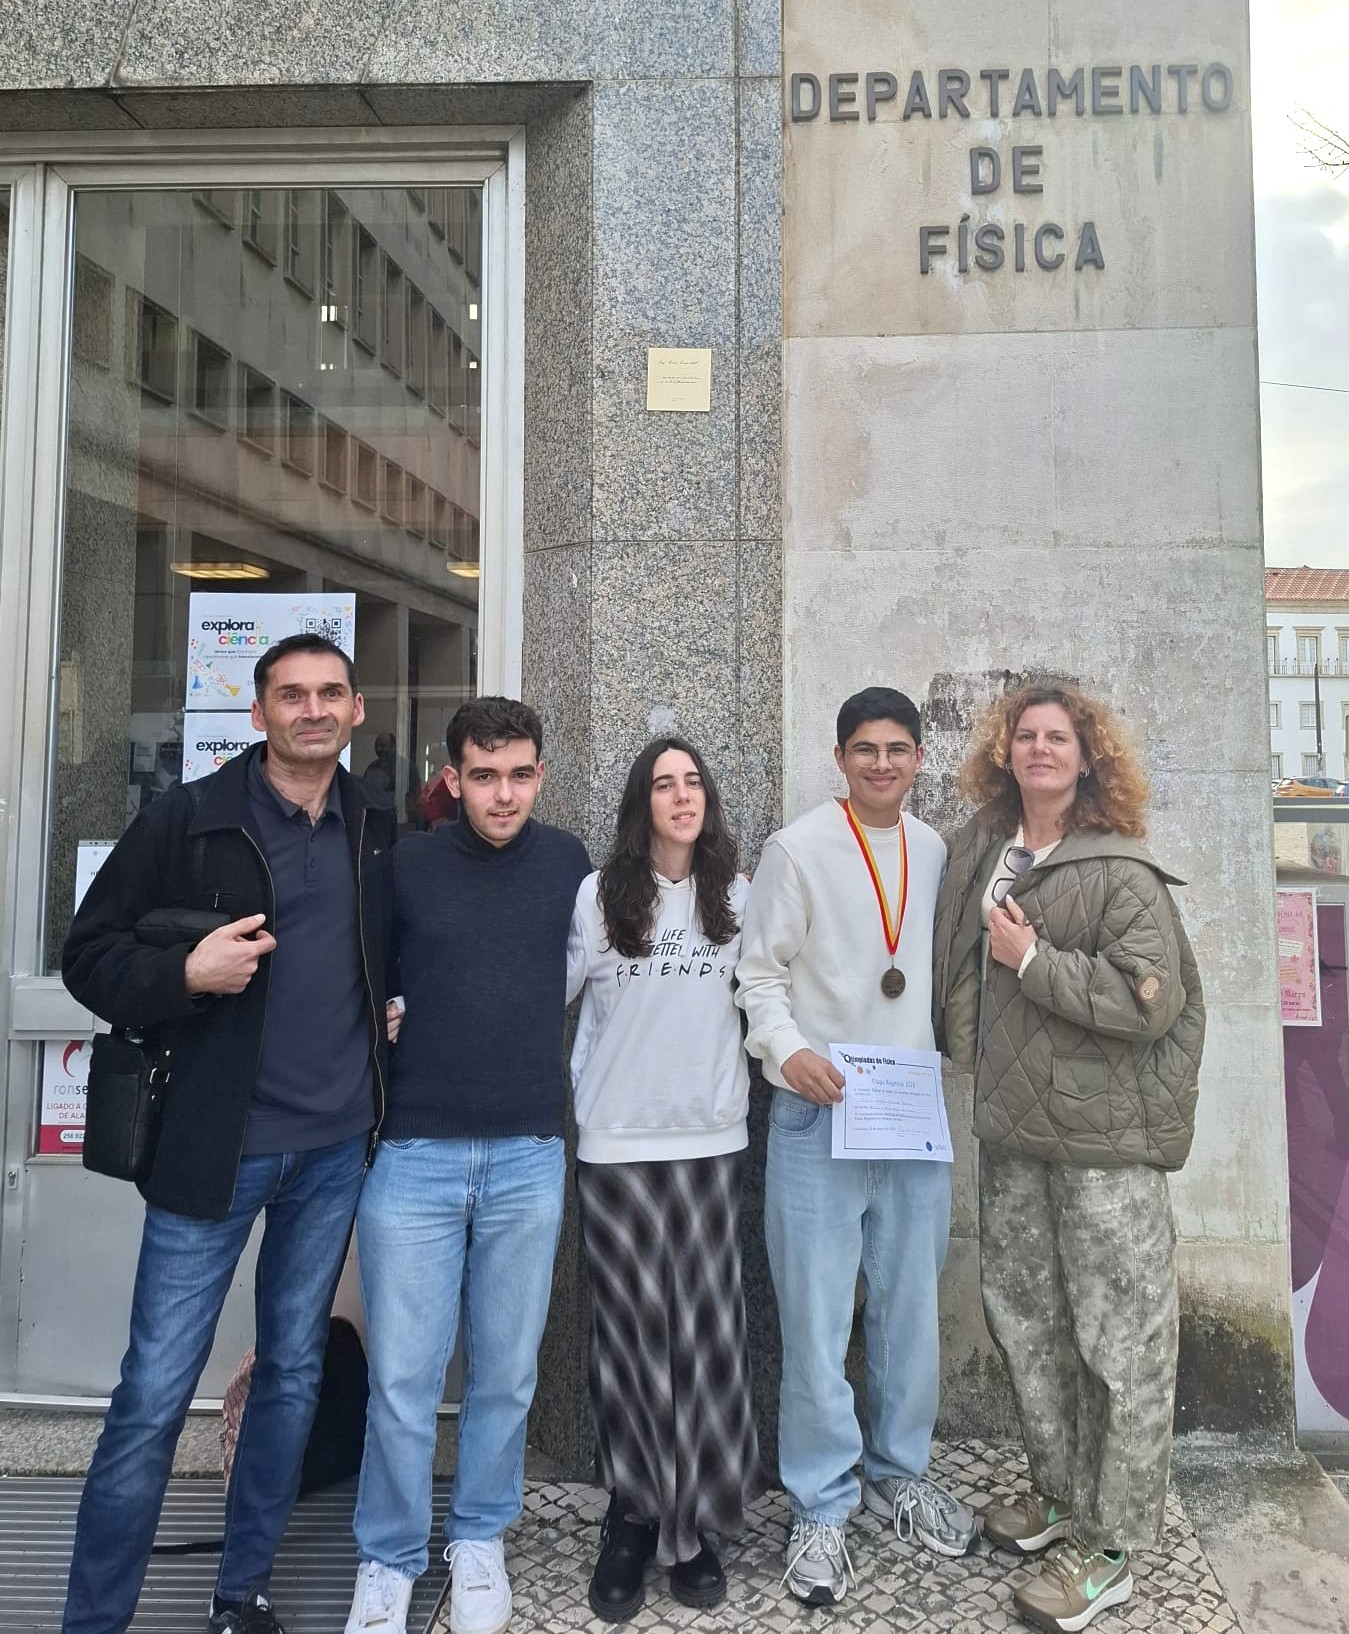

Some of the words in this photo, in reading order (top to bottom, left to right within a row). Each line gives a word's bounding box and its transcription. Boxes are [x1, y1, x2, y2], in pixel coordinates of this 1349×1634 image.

[791, 62, 1234, 121] DEPARTAMENTO
[969, 145, 1044, 195] DE
[919, 212, 1105, 274] FÍSICA
[201, 618, 255, 635] explora
[218, 630, 269, 646] ciência
[196, 738, 249, 755] explora
[661, 928, 687, 942] LIFE
[692, 944, 721, 959] WITH
